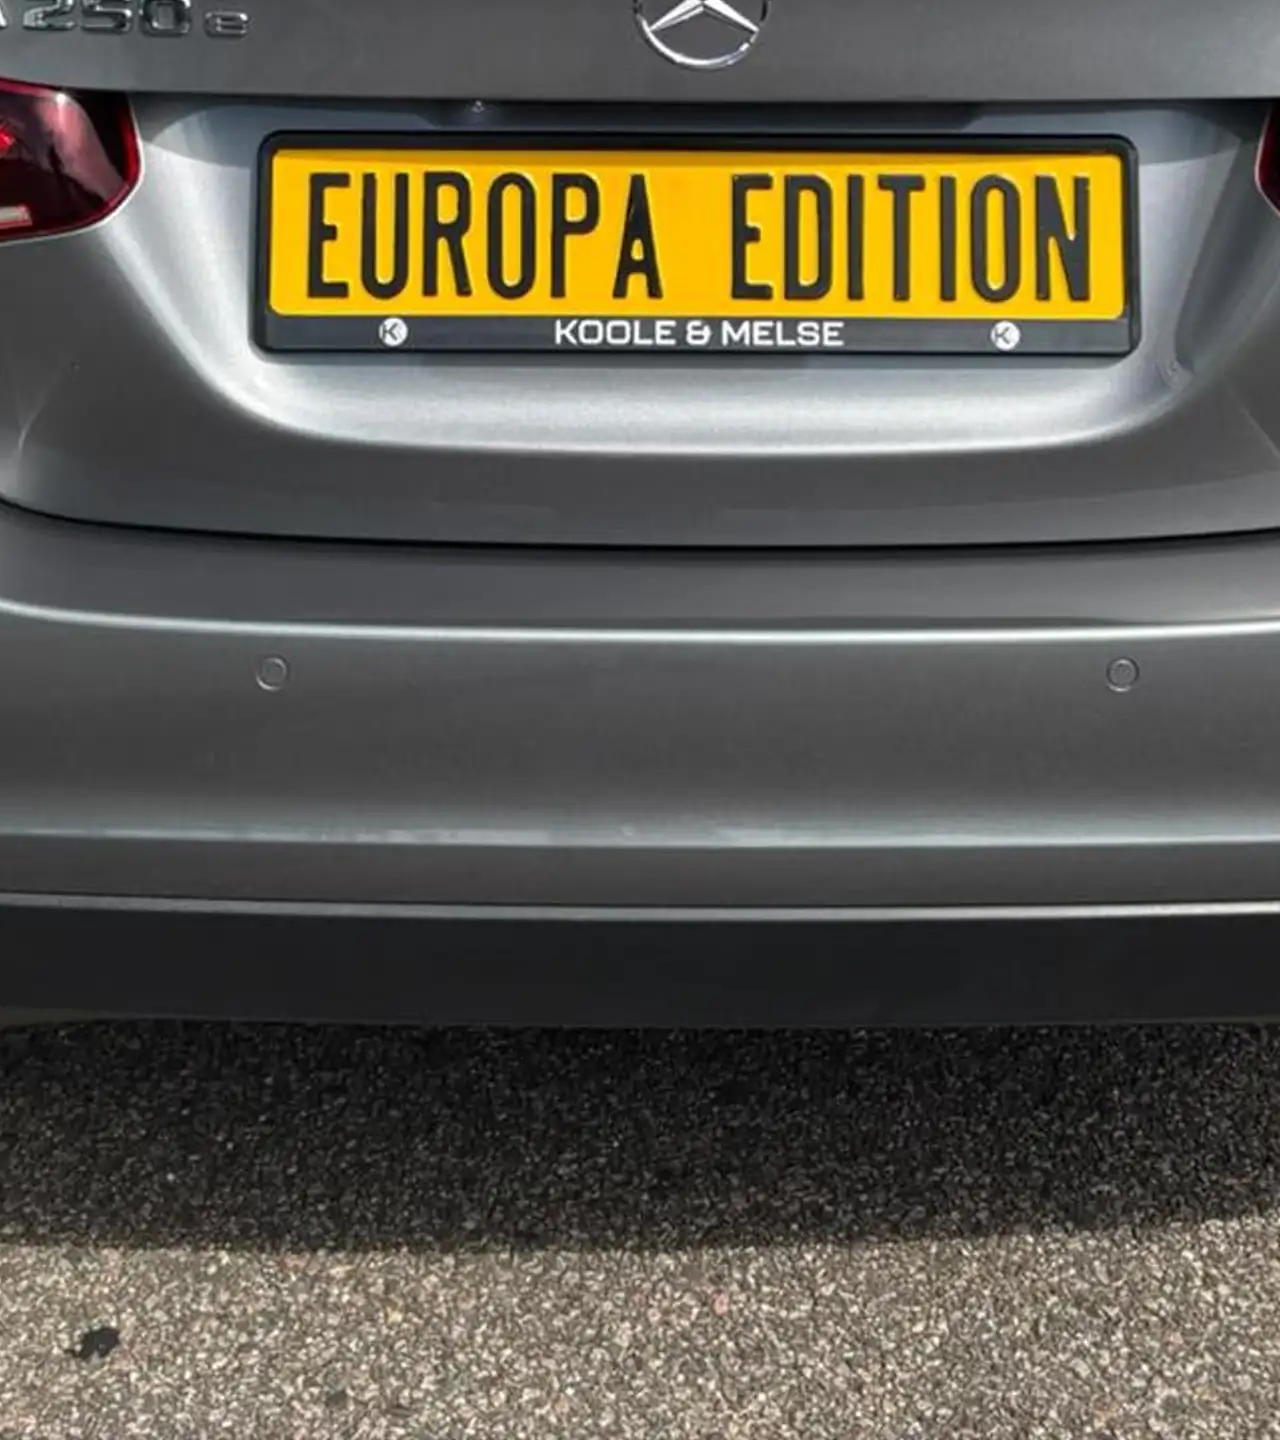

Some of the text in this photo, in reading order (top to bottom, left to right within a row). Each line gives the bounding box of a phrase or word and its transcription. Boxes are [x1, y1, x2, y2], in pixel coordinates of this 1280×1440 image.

[307, 172, 1091, 303] EUROPA EDITION
[554, 319, 845, 347] KOOLE & MELSE
